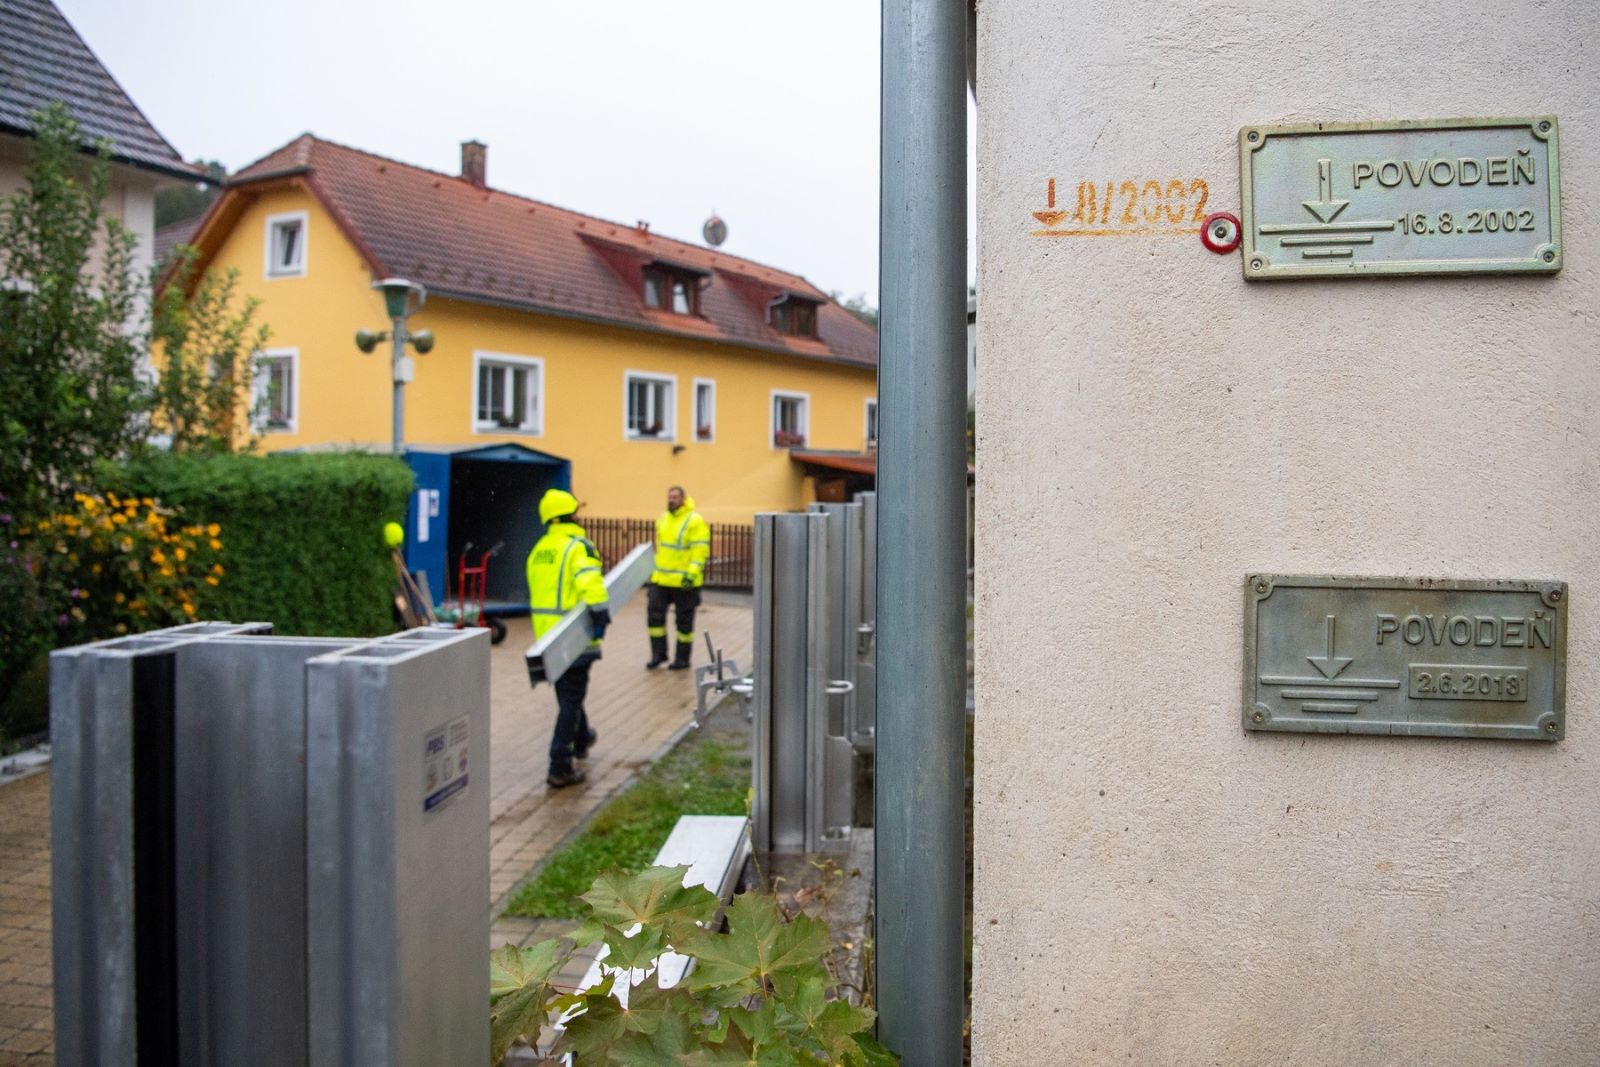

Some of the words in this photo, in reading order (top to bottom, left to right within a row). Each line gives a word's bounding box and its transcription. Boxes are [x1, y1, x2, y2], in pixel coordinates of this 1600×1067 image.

[1352, 150, 1535, 188] POVODEŇ
[1398, 209, 1535, 235] 16.8.2002
[1376, 610, 1552, 649] POVODEŇ
[1417, 671, 1520, 696] 2.6.2013
